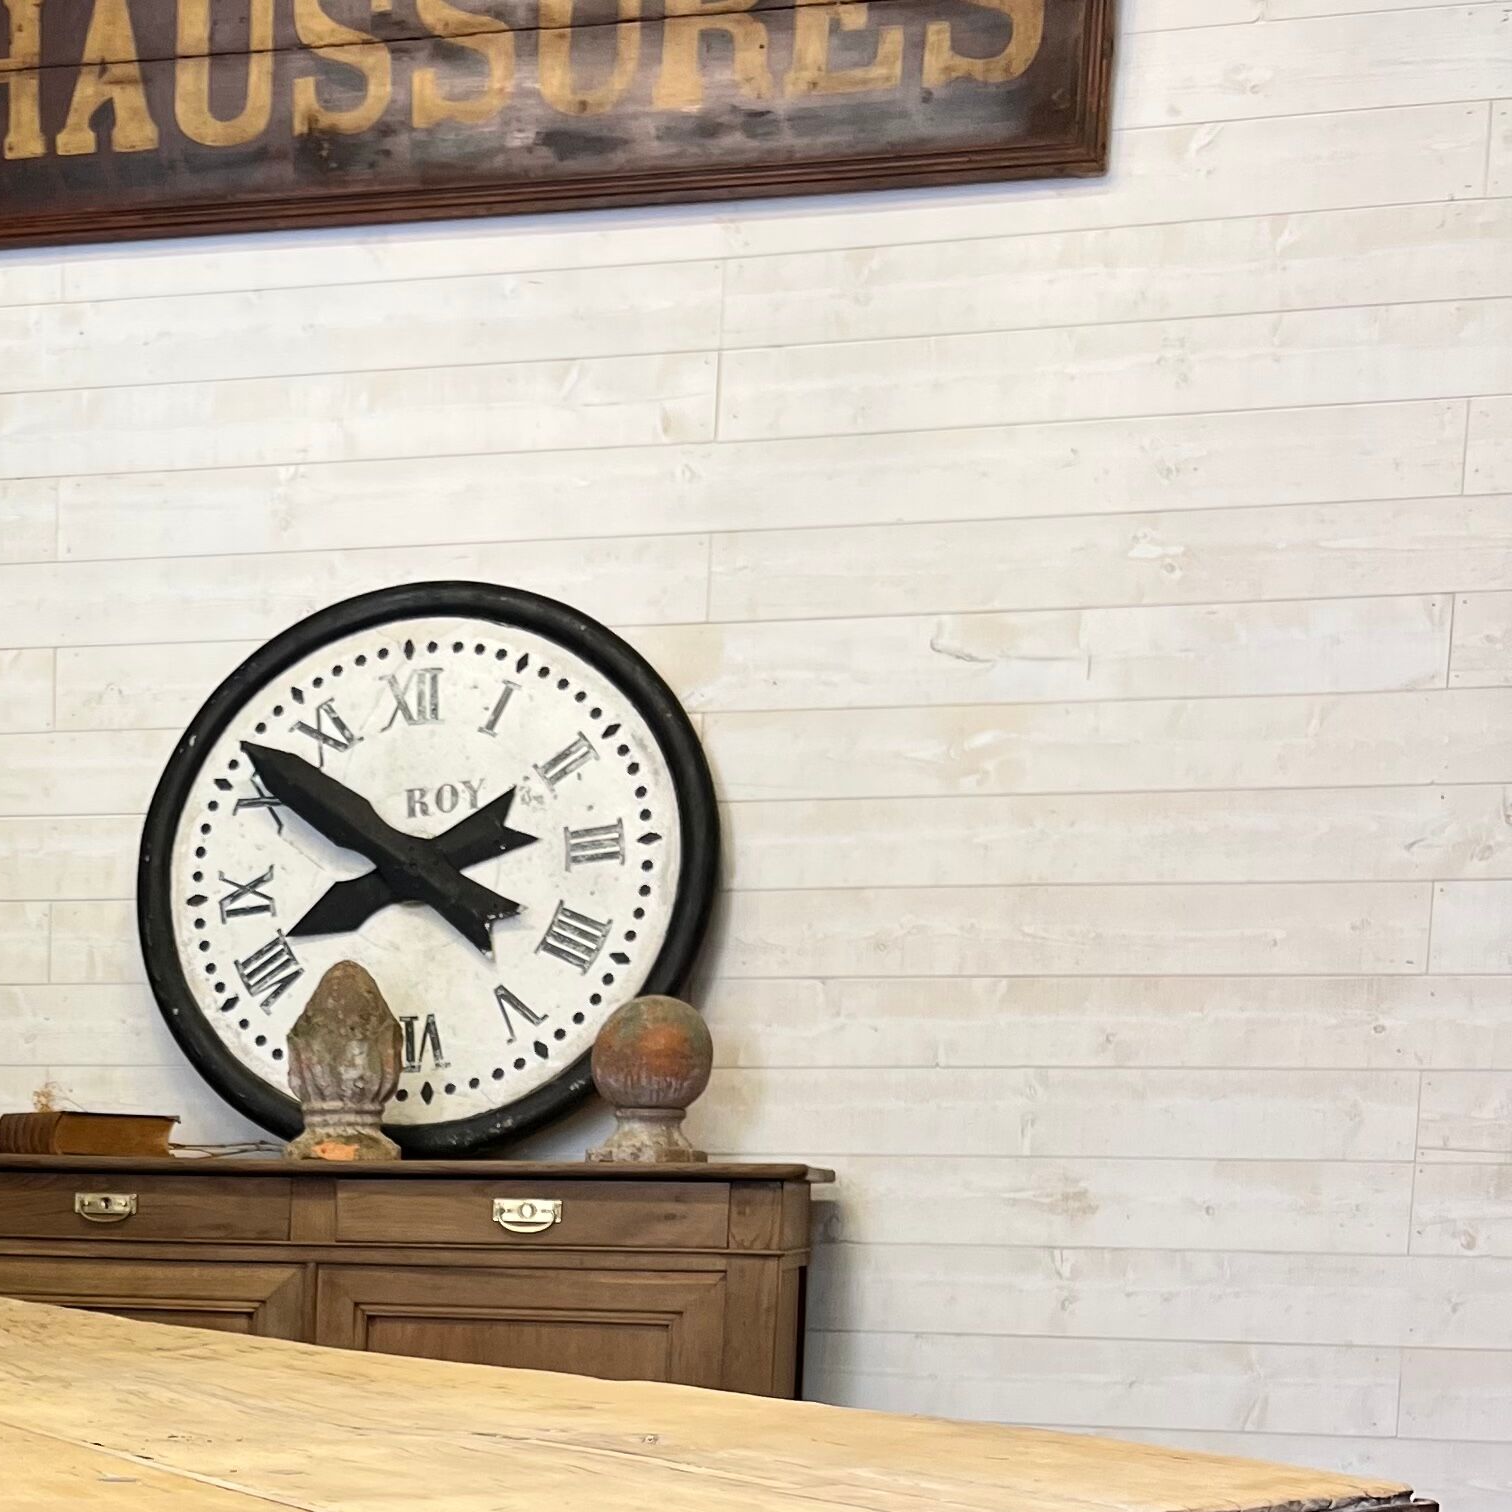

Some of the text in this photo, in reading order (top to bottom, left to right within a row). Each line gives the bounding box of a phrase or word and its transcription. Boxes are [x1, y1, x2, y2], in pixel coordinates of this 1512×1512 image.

[379, 667, 446, 733] XII
[477, 679, 522, 738] I
[288, 697, 365, 769] XI
[532, 730, 601, 800] II
[405, 777, 487, 819] ROY
[563, 817, 626, 873] III
[218, 864, 277, 924] IX
[534, 899, 613, 976] IIII
[233, 928, 306, 1016] VIII
[399, 1013, 452, 1073] VI
[494, 984, 550, 1046] V
